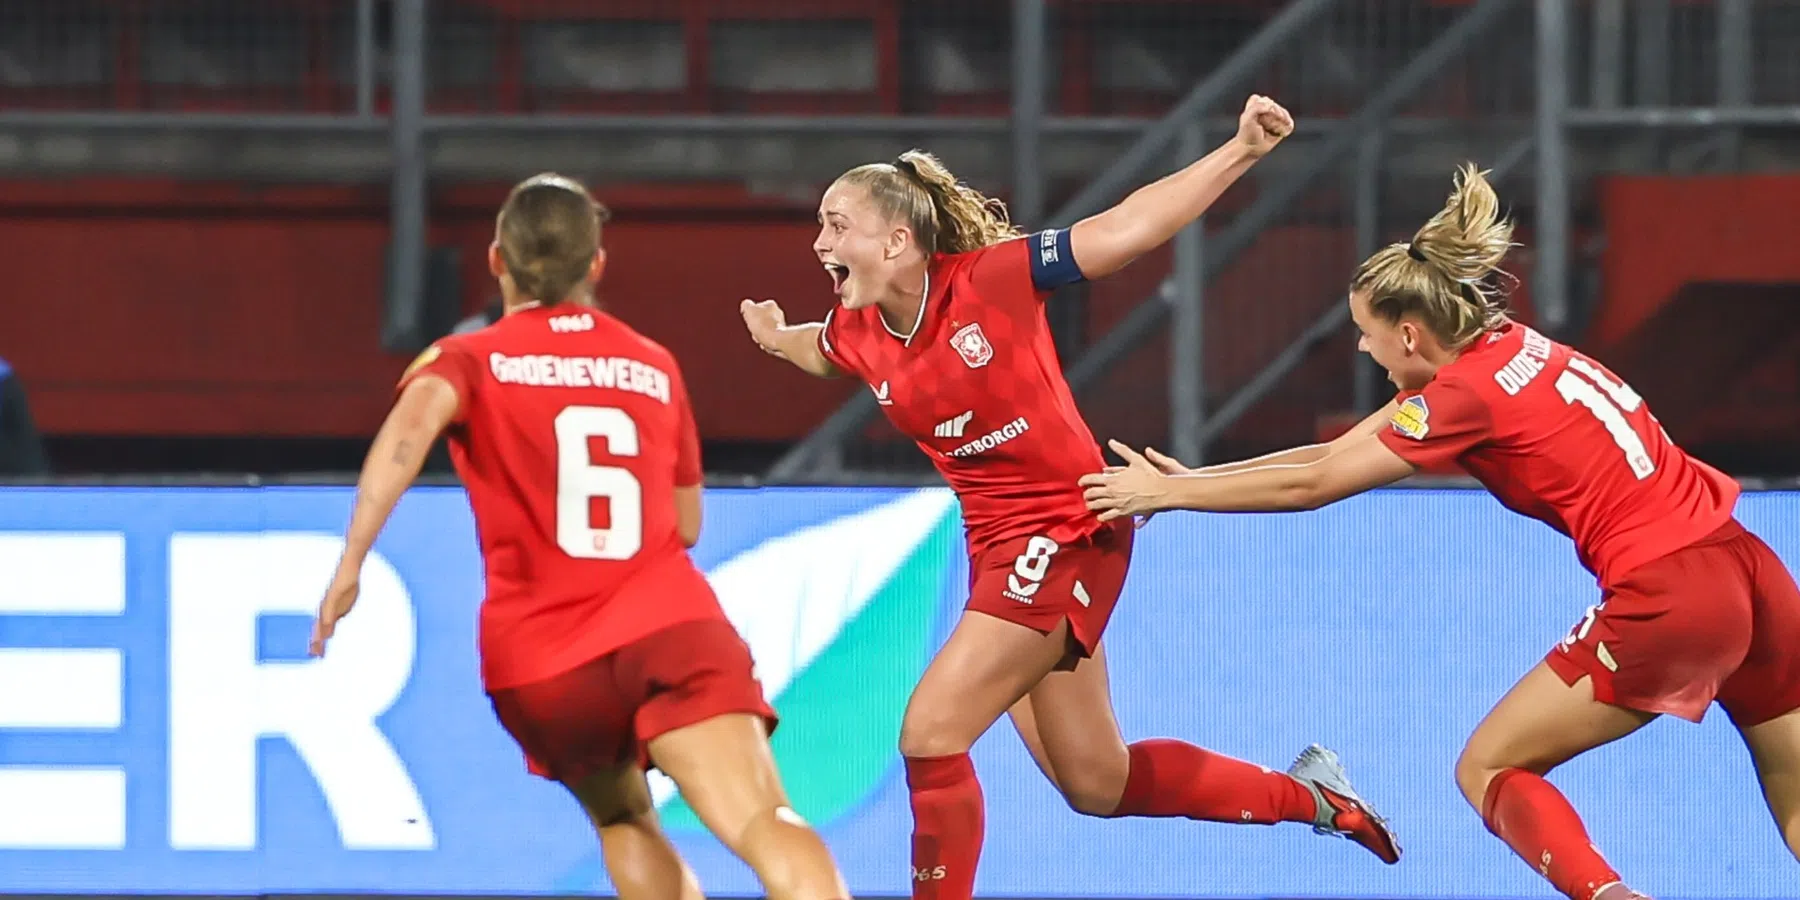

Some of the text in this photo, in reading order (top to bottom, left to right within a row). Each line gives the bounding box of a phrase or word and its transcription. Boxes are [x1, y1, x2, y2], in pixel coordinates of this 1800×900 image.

[490, 352, 670, 404] GROENEWEGEN
[1494, 347, 1546, 396] OUDE
[555, 405, 642, 560] 6
[1014, 536, 1058, 582] 8
